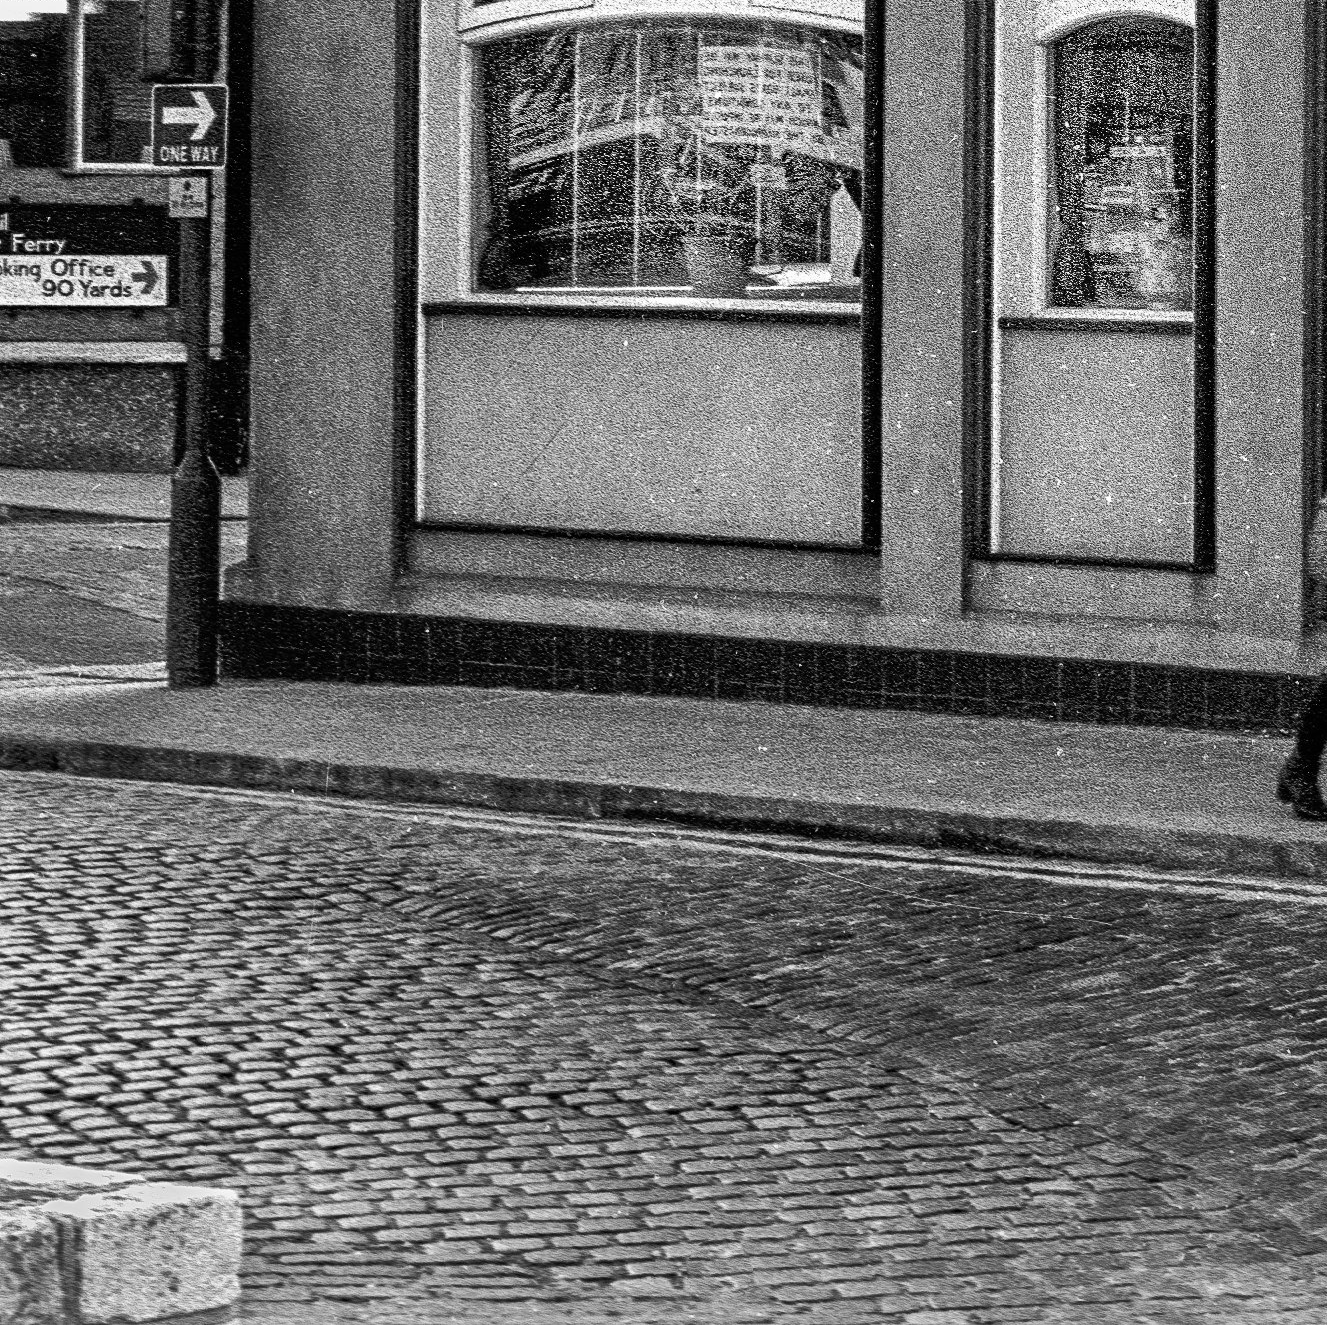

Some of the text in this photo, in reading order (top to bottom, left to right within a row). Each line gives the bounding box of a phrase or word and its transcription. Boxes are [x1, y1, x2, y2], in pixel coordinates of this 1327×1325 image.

[160, 145, 220, 163] ONE WAY
[12, 233, 66, 255] Ferry
[0, 257, 115, 283] king Office
[42, 279, 133, 298] 90 Yards
